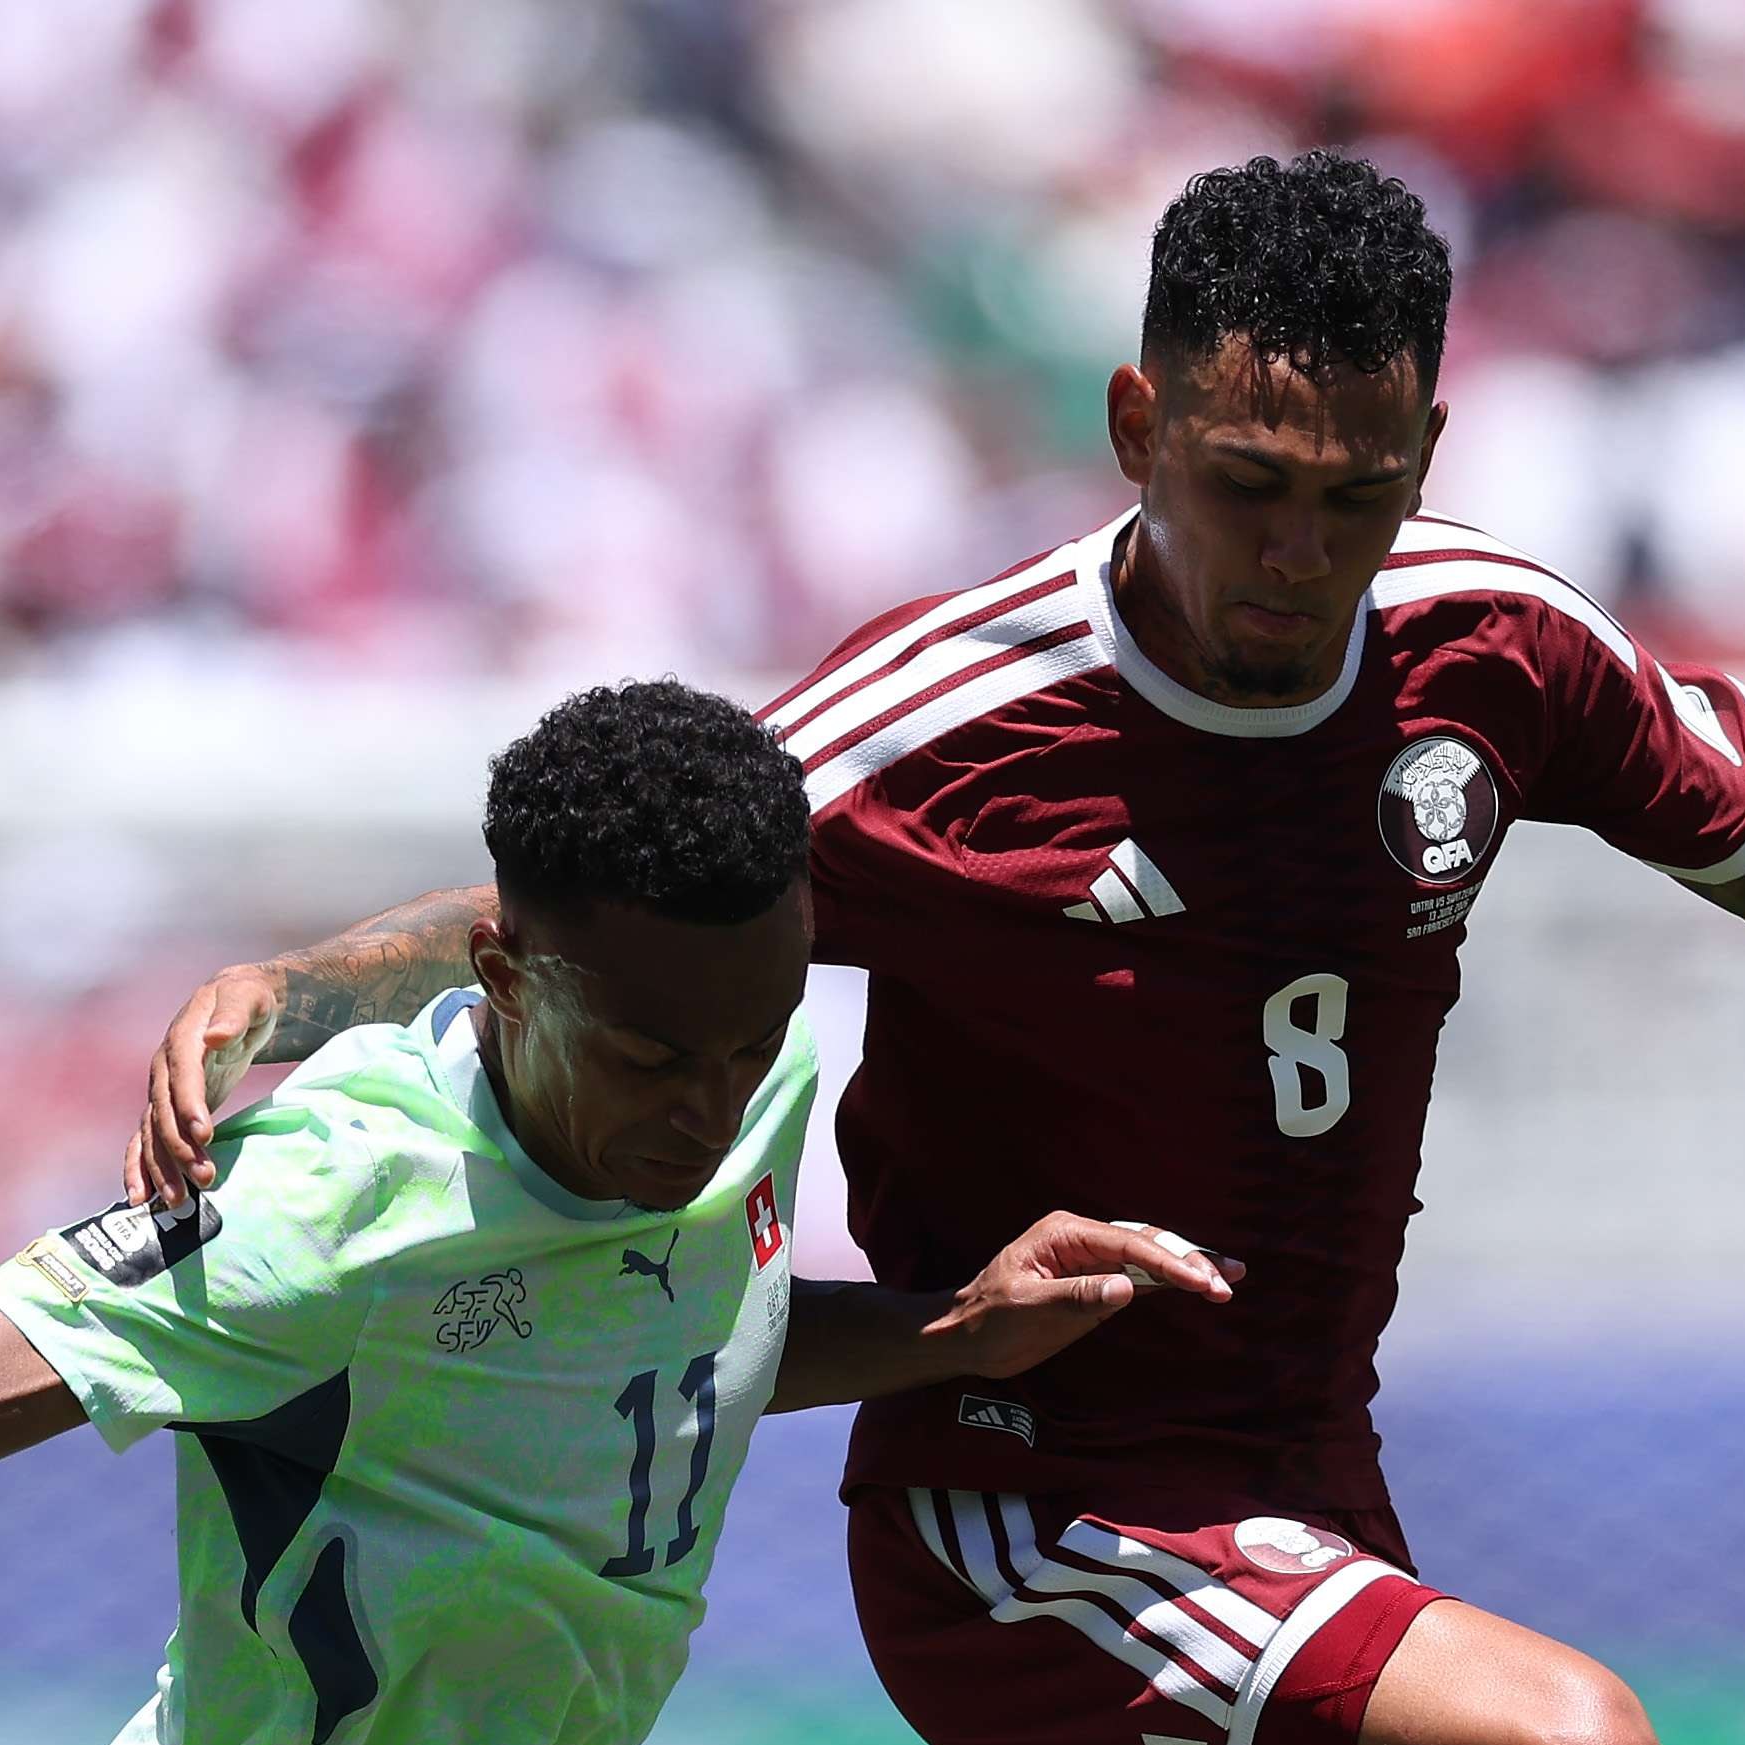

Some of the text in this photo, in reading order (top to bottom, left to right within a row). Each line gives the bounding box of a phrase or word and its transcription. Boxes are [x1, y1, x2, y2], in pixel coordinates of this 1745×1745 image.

[1422, 838, 1474, 874] QFA
[1410, 899, 1434, 914] QATAR
[1263, 972, 1350, 1138] 8
[113, 1220, 132, 1241] FIFA
[599, 1350, 718, 1577] 11
